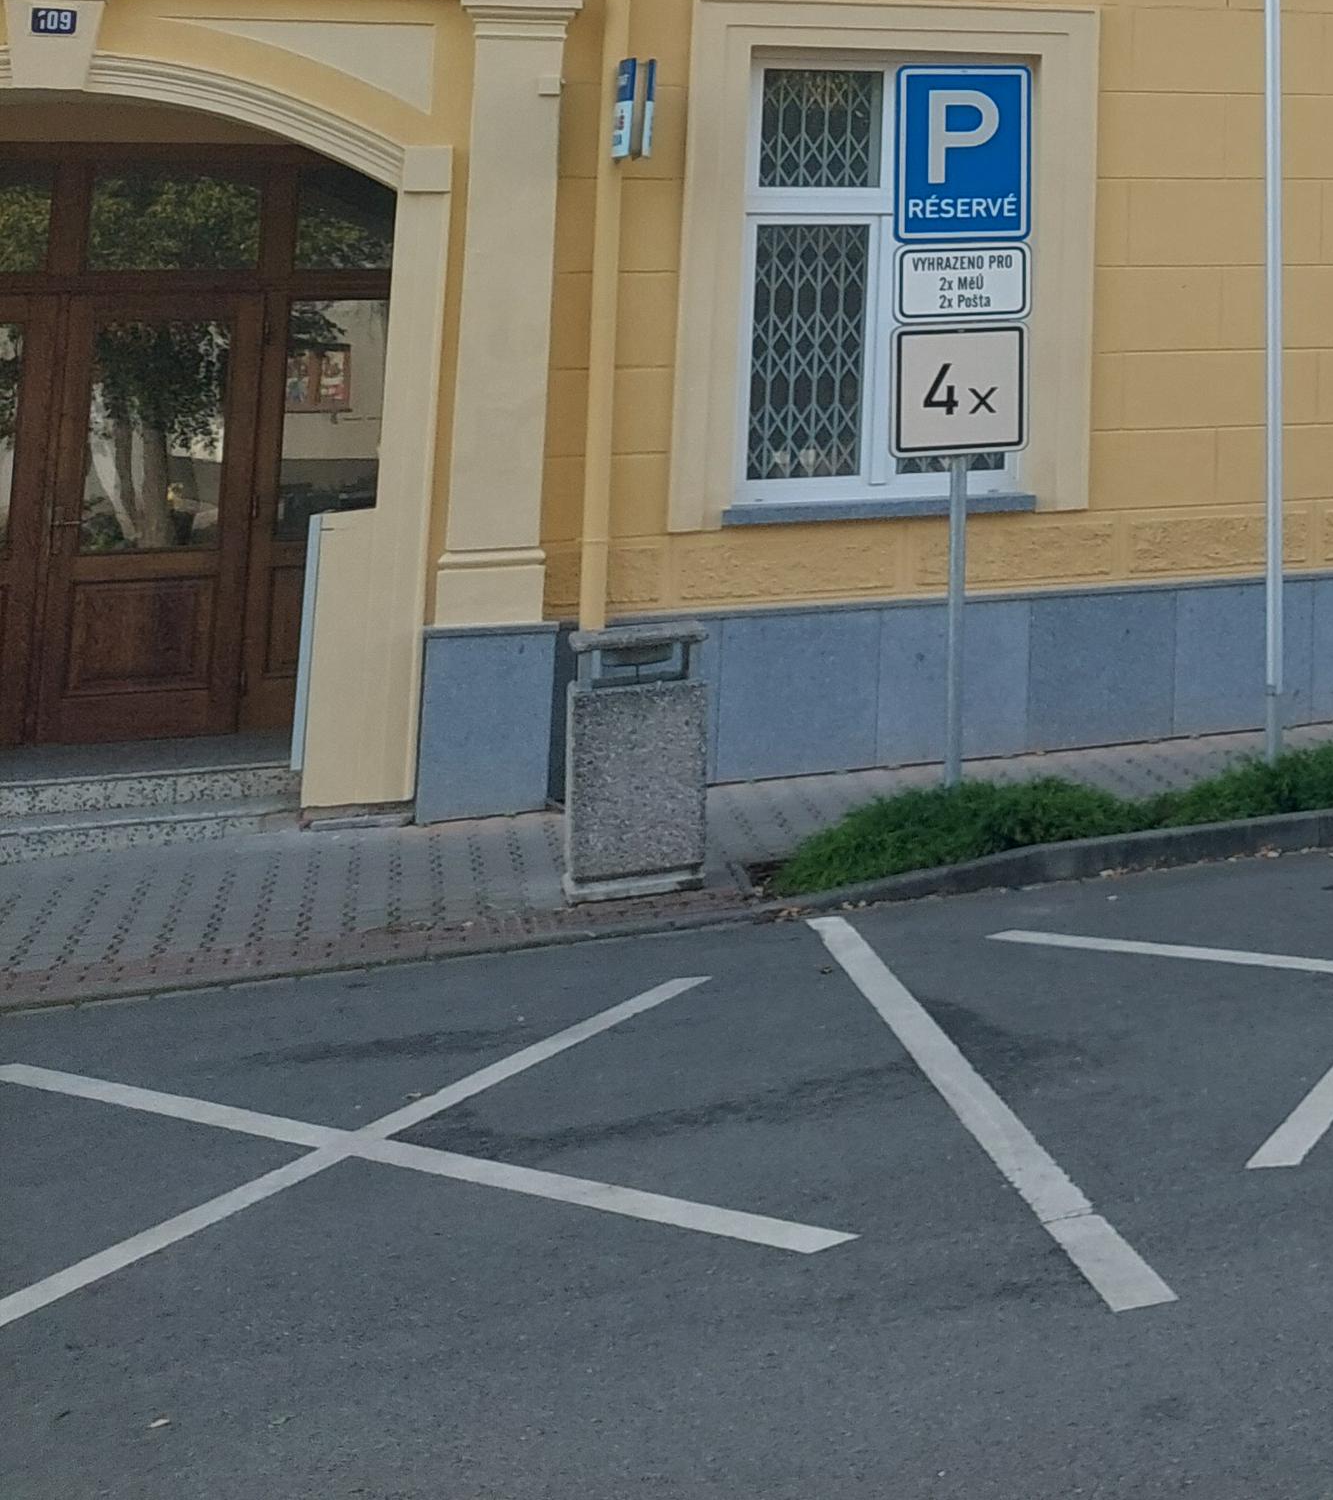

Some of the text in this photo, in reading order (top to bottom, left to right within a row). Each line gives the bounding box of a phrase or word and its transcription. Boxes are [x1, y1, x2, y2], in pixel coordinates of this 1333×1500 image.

[37, 10, 72, 30] 109
[927, 89, 1000, 184] P
[908, 193, 1017, 219] RÉSERVÉ
[912, 254, 1013, 272] VYHRAZENO PRO
[939, 272, 984, 291] 2x MěÚ
[939, 293, 991, 309] 2x Pošta
